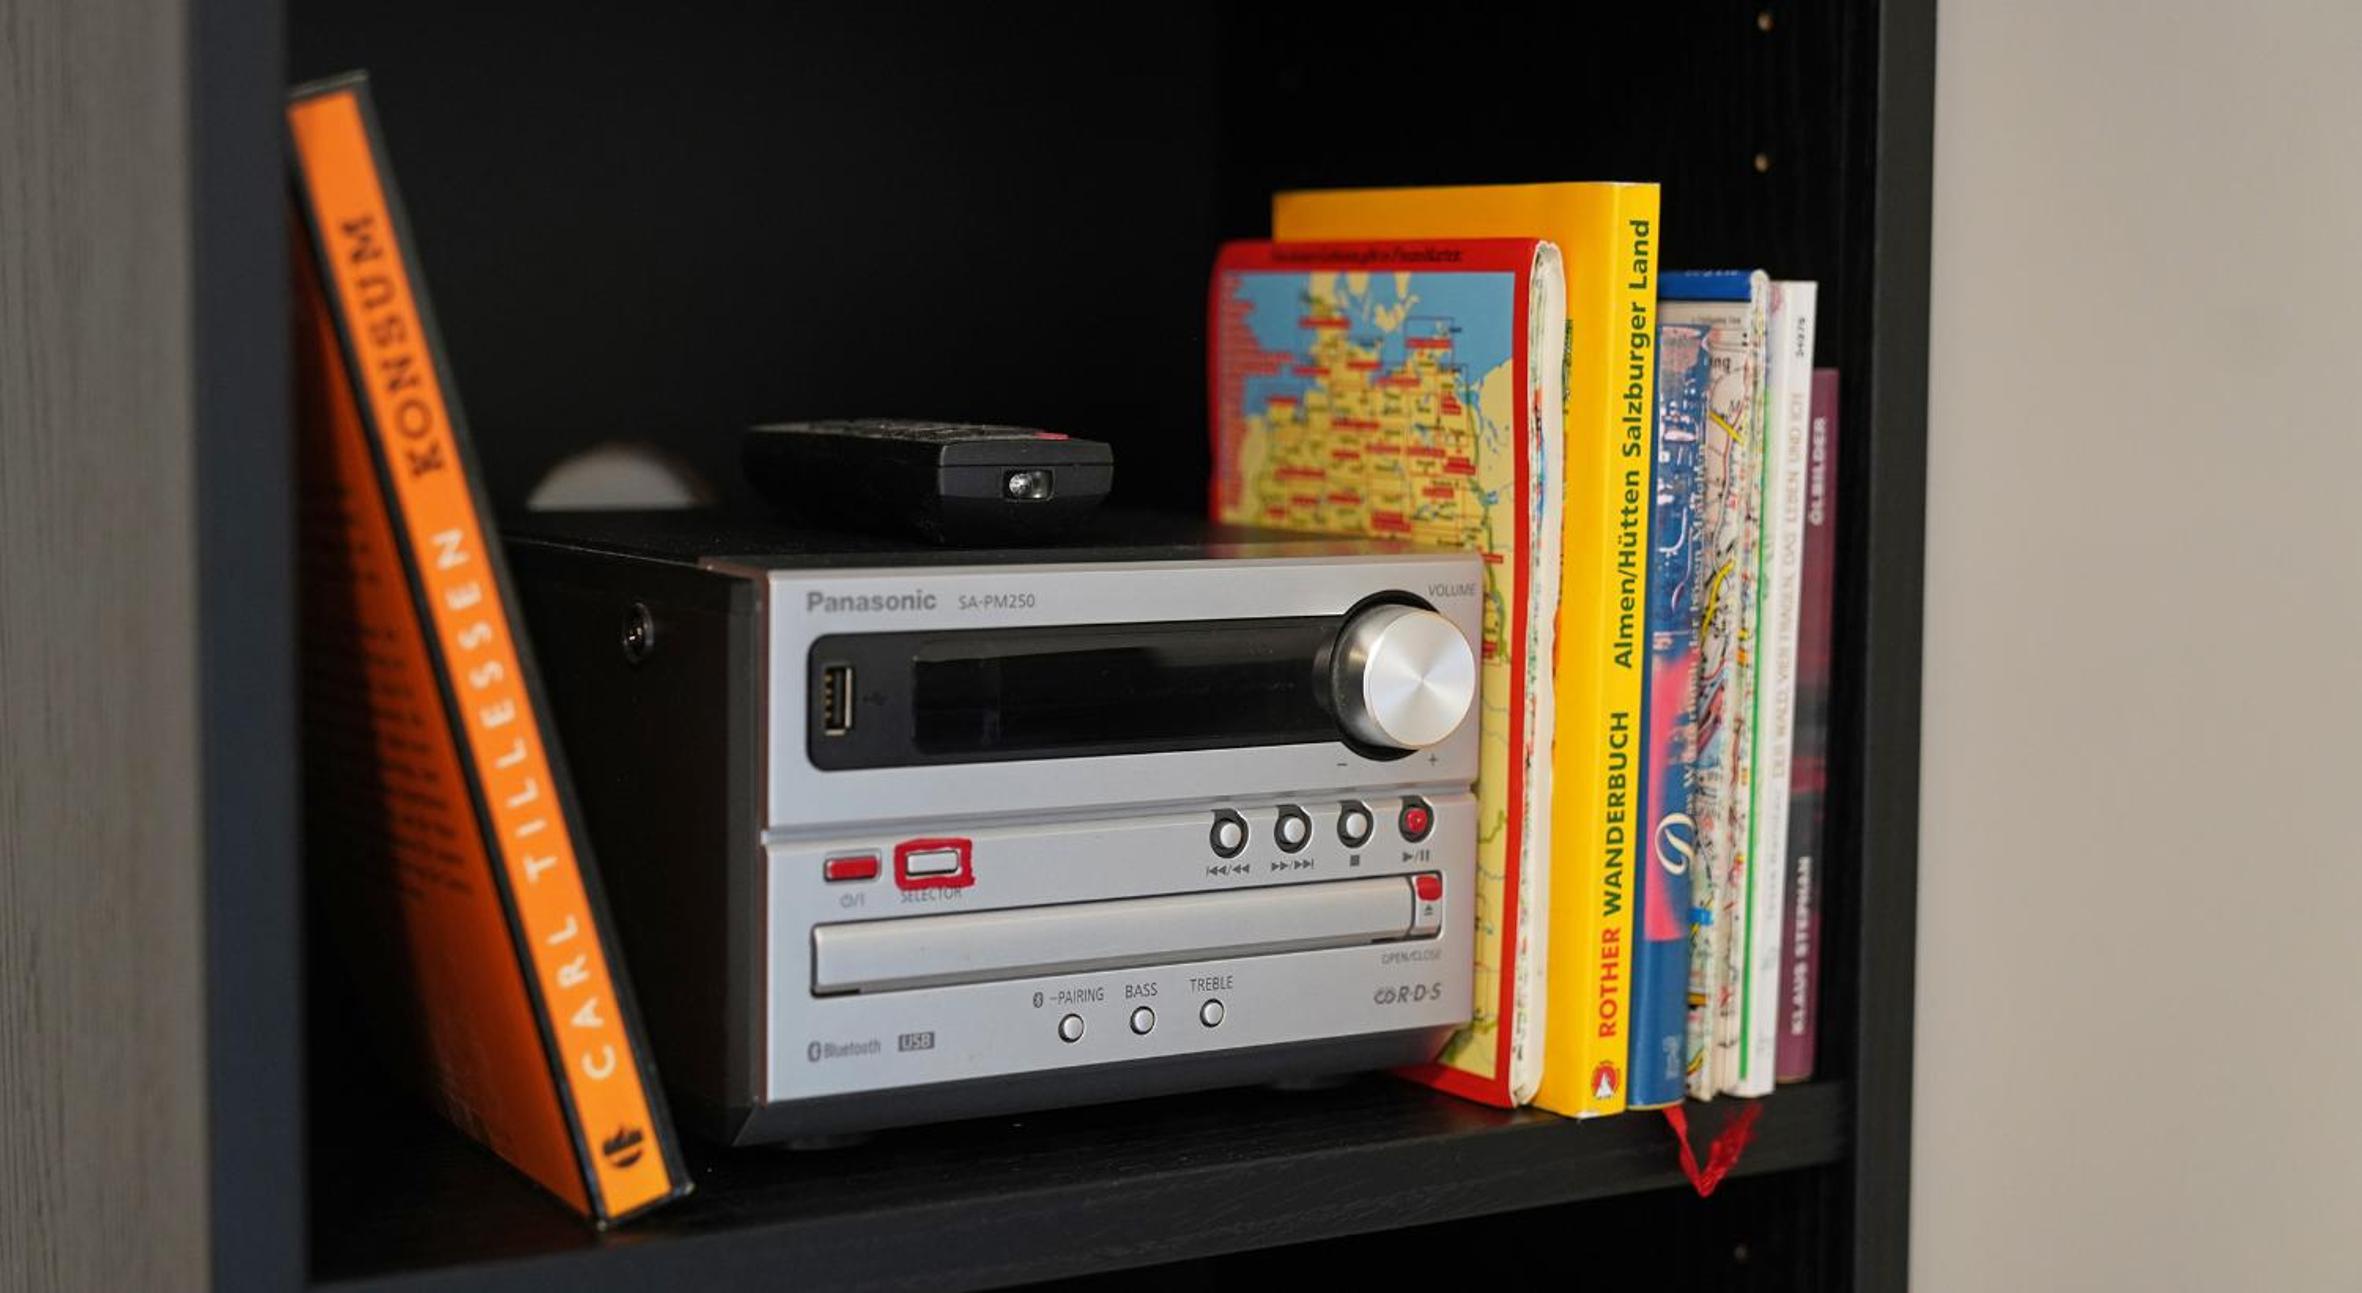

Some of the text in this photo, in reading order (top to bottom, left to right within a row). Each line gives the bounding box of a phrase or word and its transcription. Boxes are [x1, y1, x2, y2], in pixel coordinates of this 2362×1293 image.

[341, 214, 446, 479] KONSUM
[1614, 219, 1650, 669] Almen/Hütten Salzburger Land
[1427, 583, 1477, 597] VOLUME
[806, 589, 1037, 613] Panasonic SA-PM250
[432, 526, 617, 1080] CARL TILLESSEN
[1598, 711, 1629, 1038] ROTHER WANDERBUCH
[900, 886, 963, 904] SELECTOR
[1791, 855, 1812, 1036] KLAUS STEPHAN
[1380, 948, 1442, 965] OPEN/CLOSE
[1124, 981, 1158, 999] BASS
[1189, 975, 1234, 993] TREBLE
[823, 1039, 882, 1059] Bluetooth
[901, 1032, 932, 1050] USB
